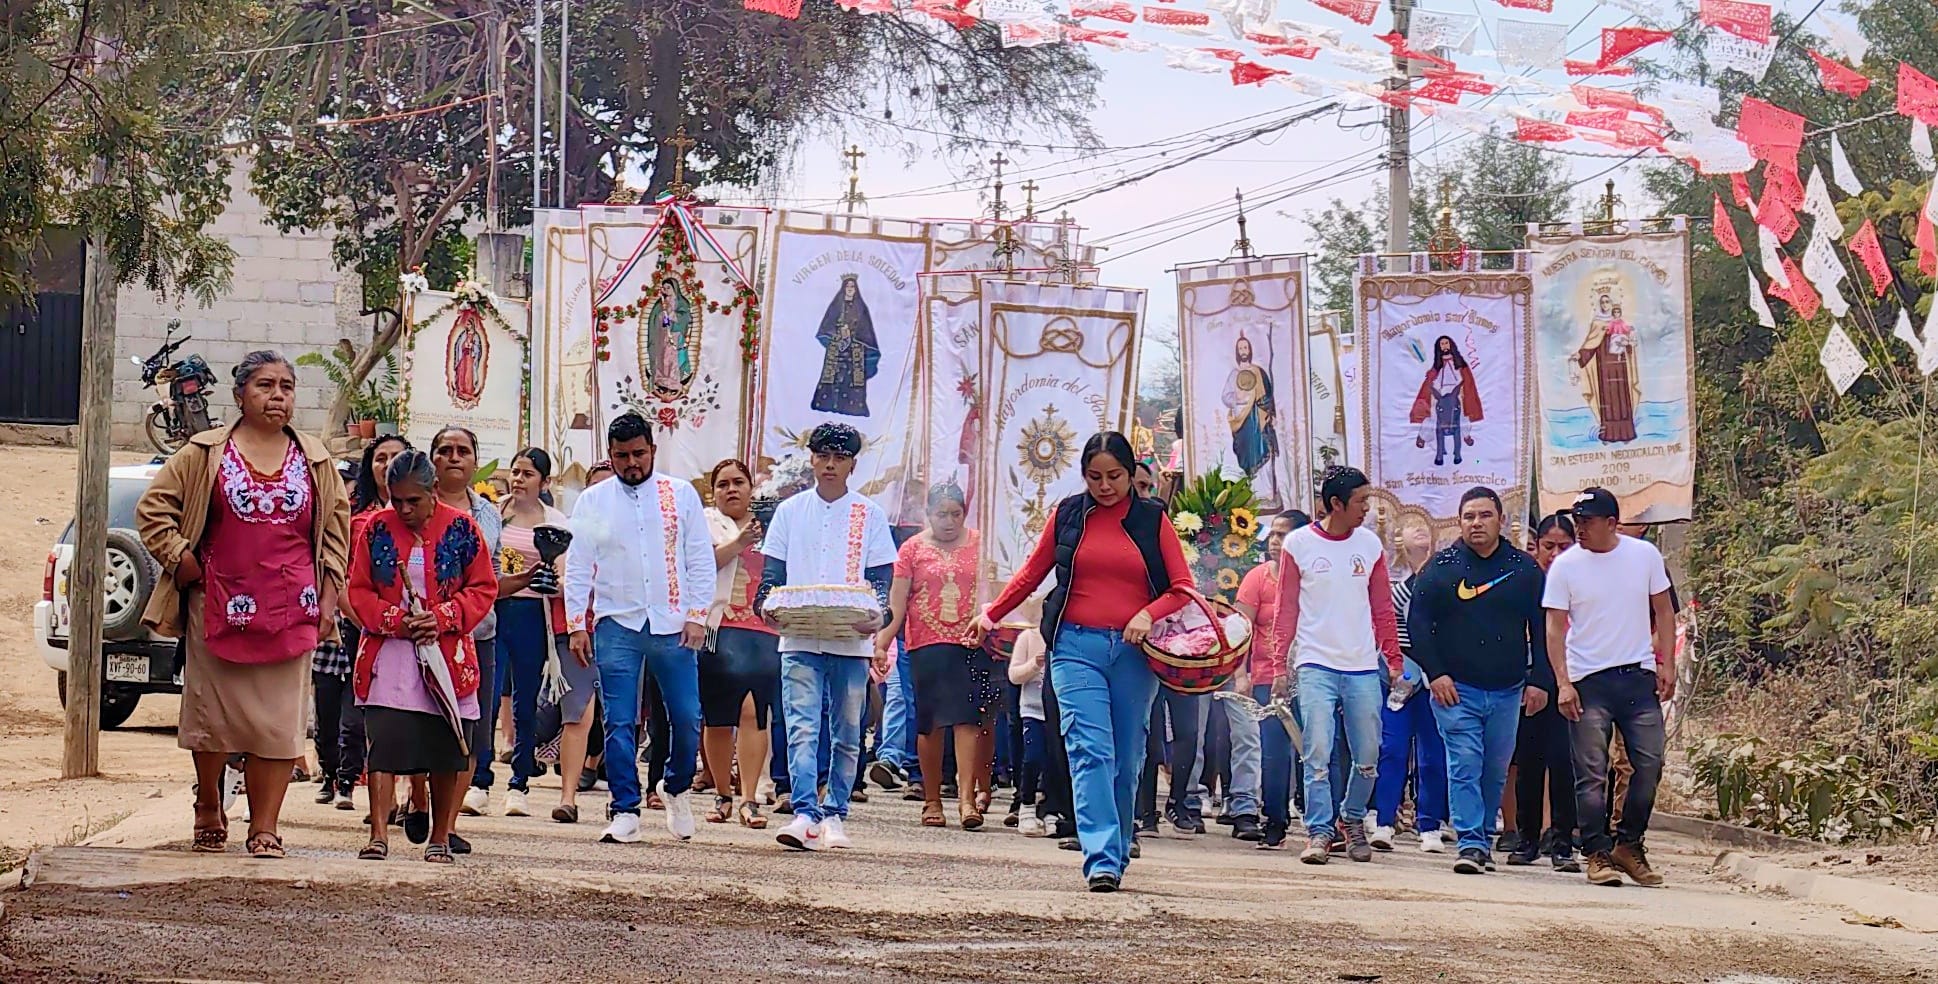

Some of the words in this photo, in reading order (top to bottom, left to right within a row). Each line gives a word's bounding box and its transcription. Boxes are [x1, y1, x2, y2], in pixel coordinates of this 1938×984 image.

[792, 252, 831, 285] VIRGEN
[837, 250, 849, 261] DE
[851, 251, 863, 263] LA
[868, 255, 906, 291] SOLEDAD
[1542, 252, 1579, 277] NUESTRA
[1619, 249, 1636, 261] DEL
[1061, 377, 1092, 396] del
[1550, 456, 1567, 466] SAN
[1567, 451, 1607, 465] ESTEBAN
[1601, 462, 1630, 475] 2009
